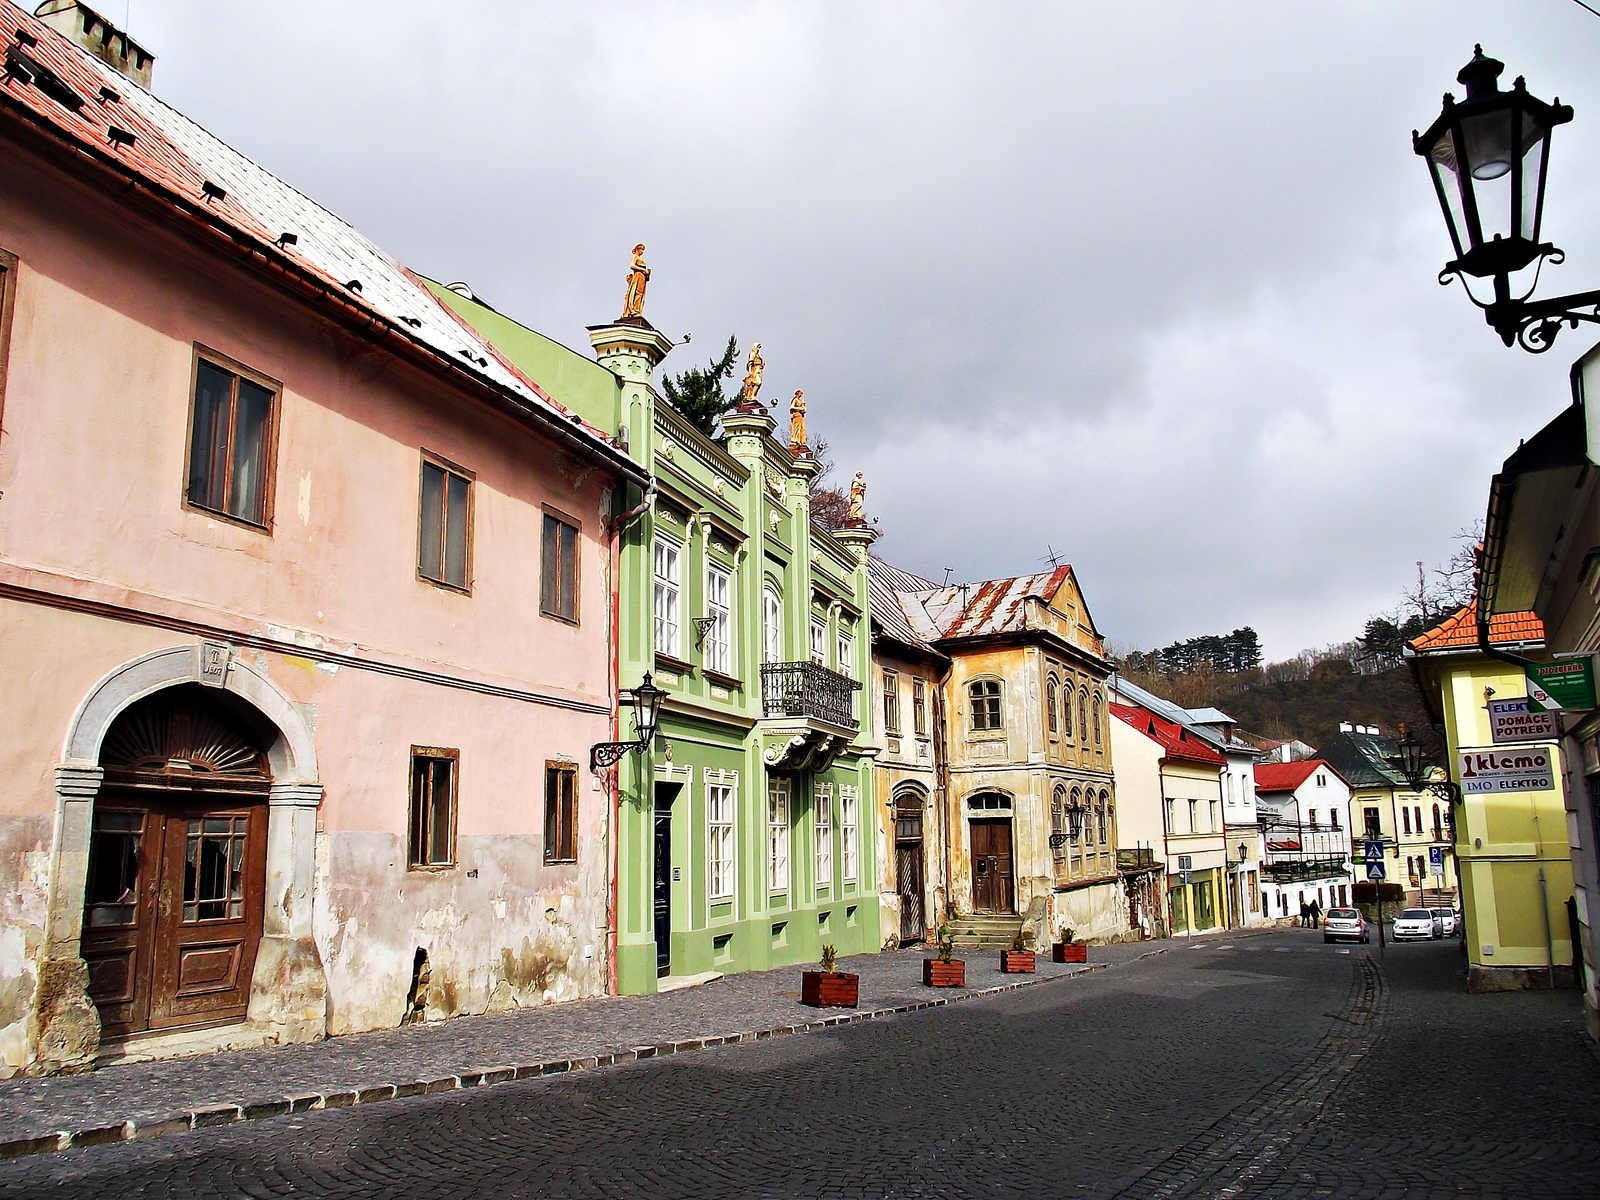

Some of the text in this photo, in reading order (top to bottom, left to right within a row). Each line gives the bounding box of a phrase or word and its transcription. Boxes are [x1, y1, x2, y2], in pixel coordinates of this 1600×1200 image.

[1497, 713, 1549, 726] DOMÁCE
[1496, 724, 1552, 737] POTREBY
[1467, 778, 1549, 791] IMO ELEKTRO
